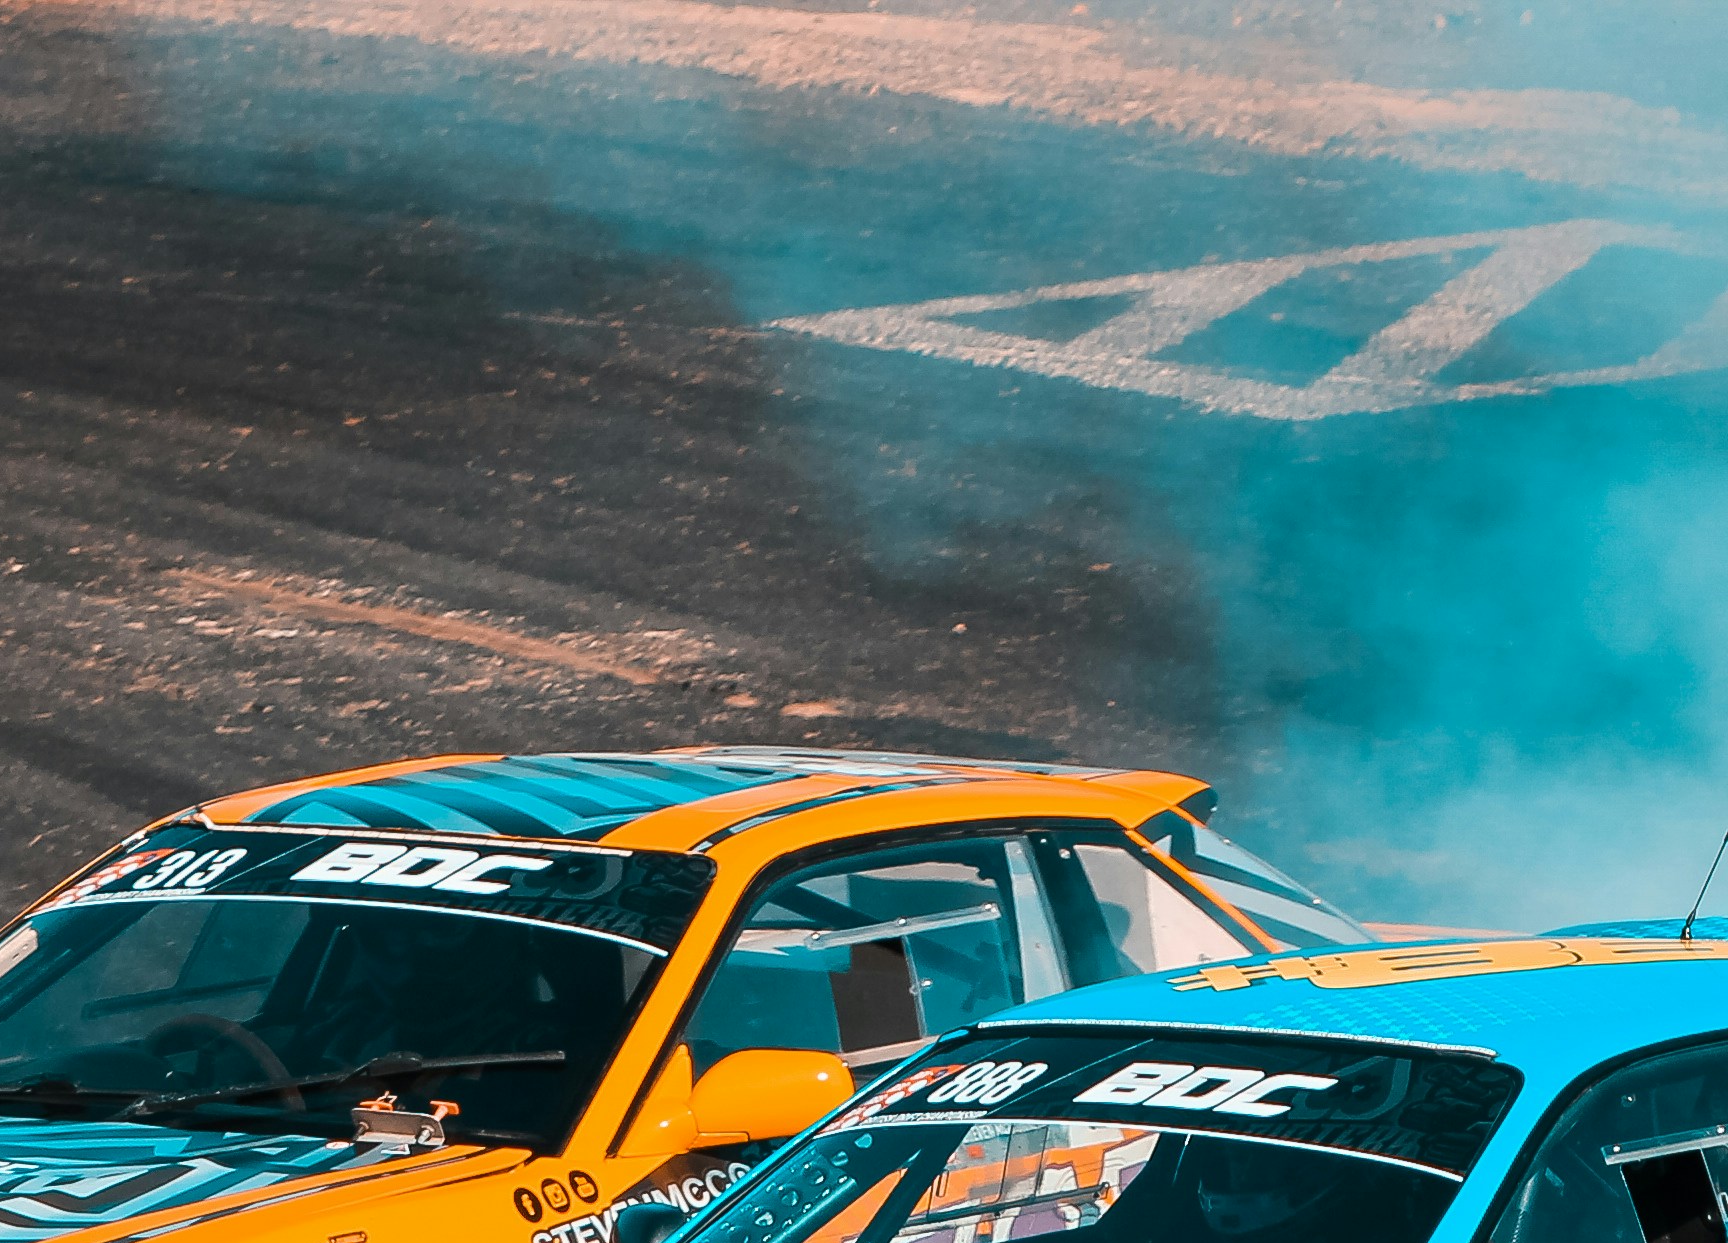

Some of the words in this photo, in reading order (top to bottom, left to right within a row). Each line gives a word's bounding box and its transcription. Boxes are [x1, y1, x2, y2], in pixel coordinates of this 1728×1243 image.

[133, 849, 248, 889] 313
[290, 842, 553, 894] BDC
[927, 1062, 1048, 1104] 888
[1073, 1062, 1338, 1117] BDC
